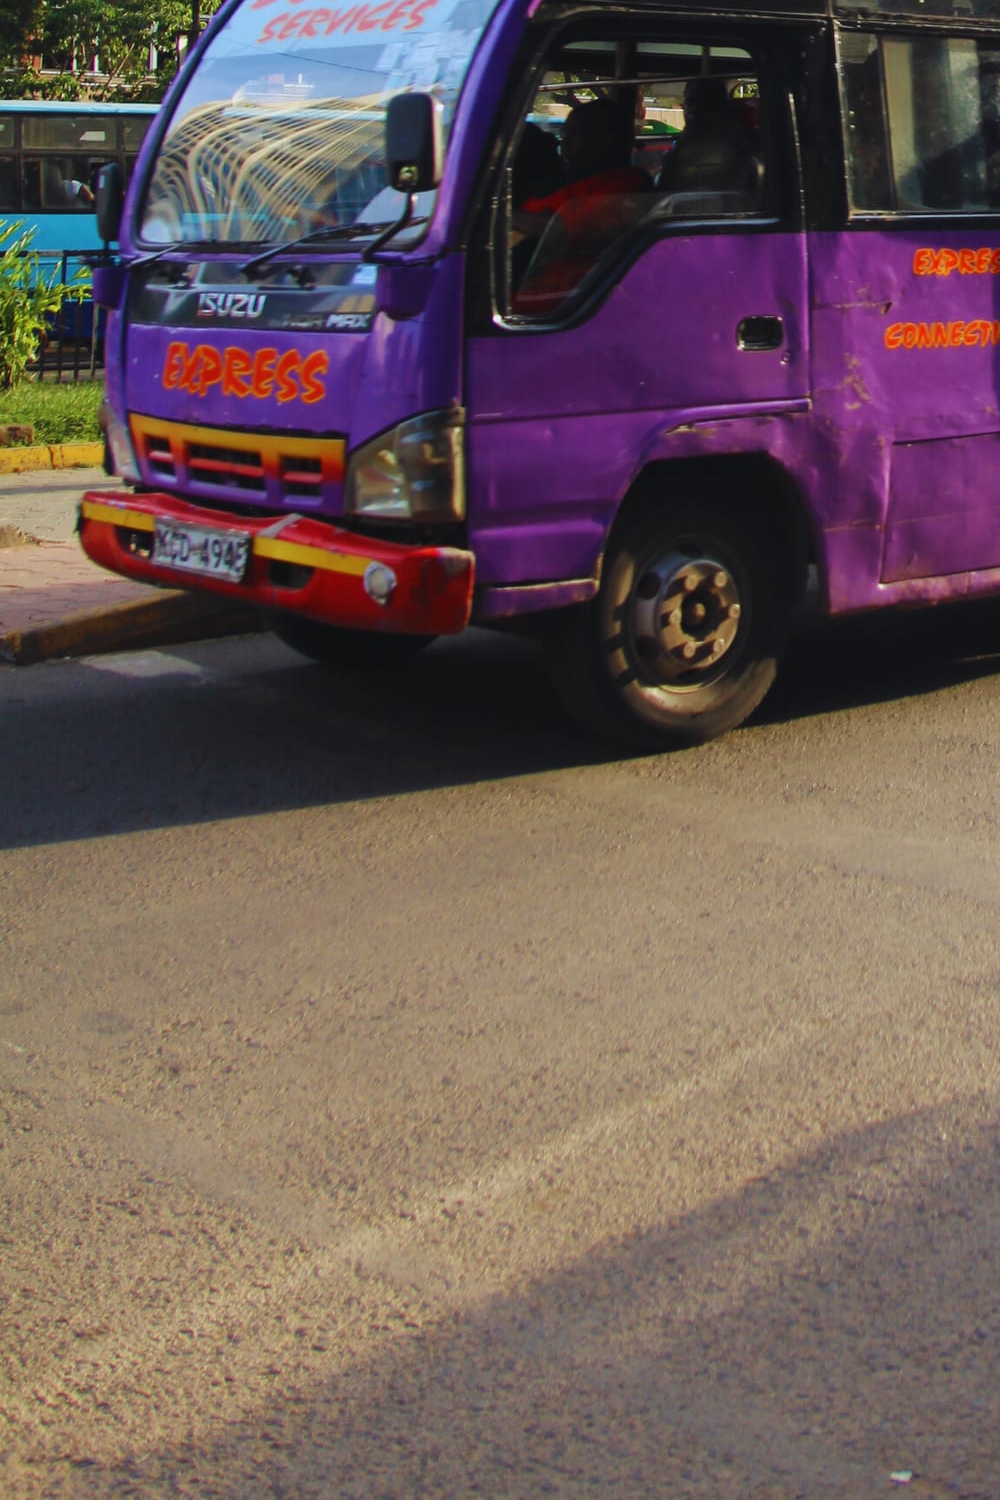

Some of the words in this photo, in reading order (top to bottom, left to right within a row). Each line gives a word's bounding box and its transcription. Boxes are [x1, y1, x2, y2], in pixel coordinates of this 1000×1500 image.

[197, 293, 267, 318] ISUZU
[325, 313, 372, 329] MAX
[162, 341, 330, 404] EXPRESS
